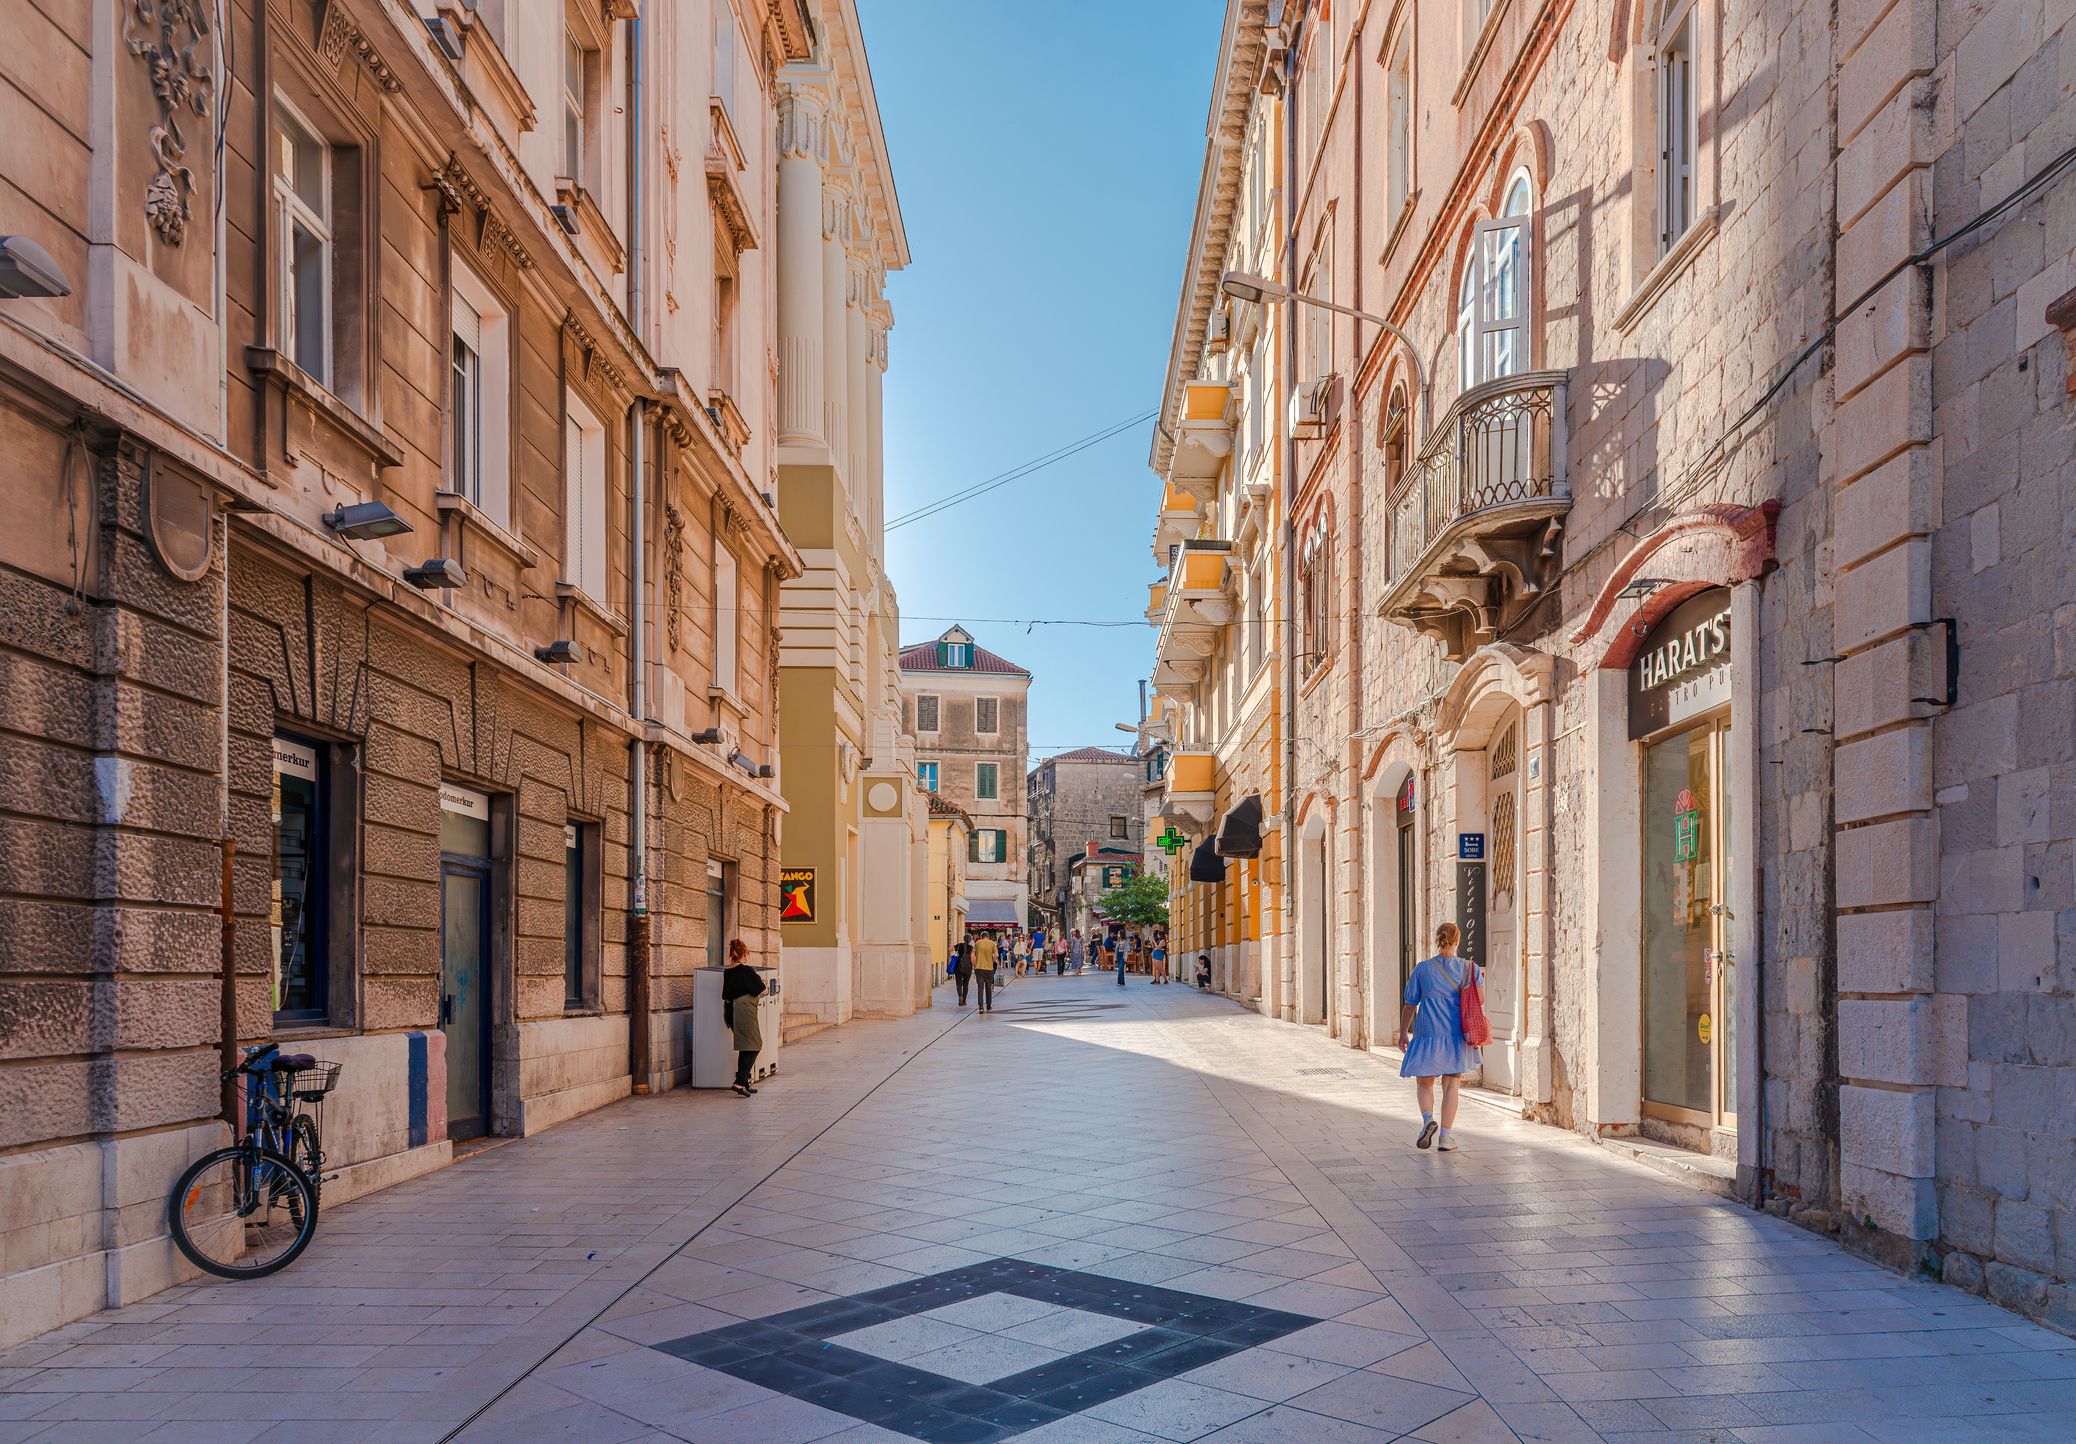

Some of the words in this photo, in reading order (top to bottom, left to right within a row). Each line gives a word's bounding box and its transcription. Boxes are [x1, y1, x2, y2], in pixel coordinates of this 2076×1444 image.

[1640, 612, 1725, 692] HARAT'S
[1650, 682, 1698, 718] GTRO
[1709, 664, 1732, 691] PU
[780, 872, 813, 881] TANGO
[1463, 866, 1480, 913] Villa
